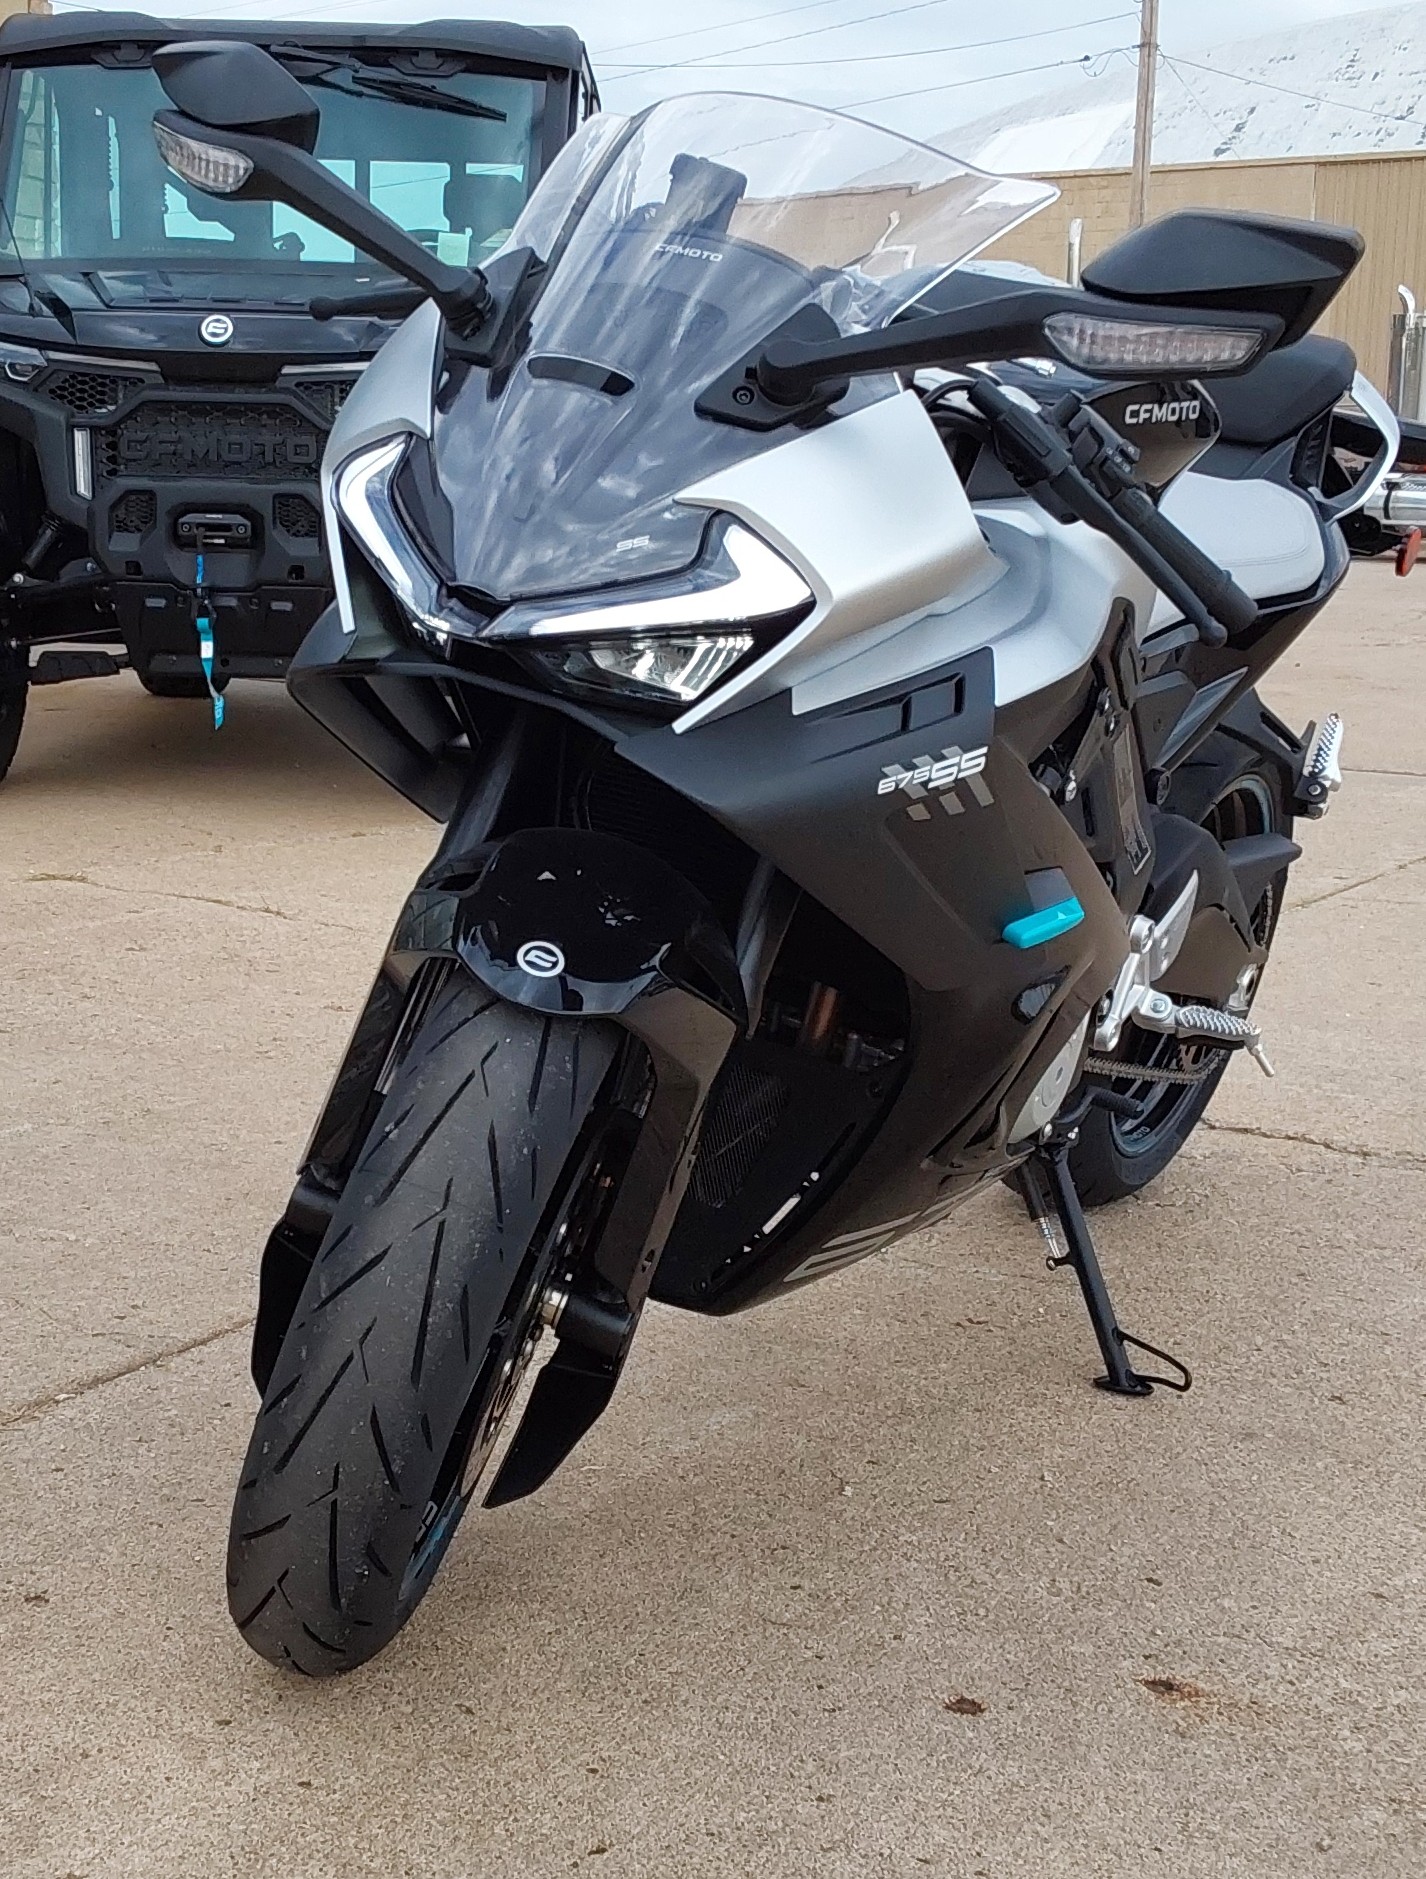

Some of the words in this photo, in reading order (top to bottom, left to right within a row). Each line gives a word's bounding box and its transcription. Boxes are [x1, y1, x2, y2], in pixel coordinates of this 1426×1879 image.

[655, 243, 723, 262] CFMOTO
[1124, 400, 1200, 424] CFMOTO
[119, 430, 318, 465] CFMOTO
[616, 535, 650, 552] SS
